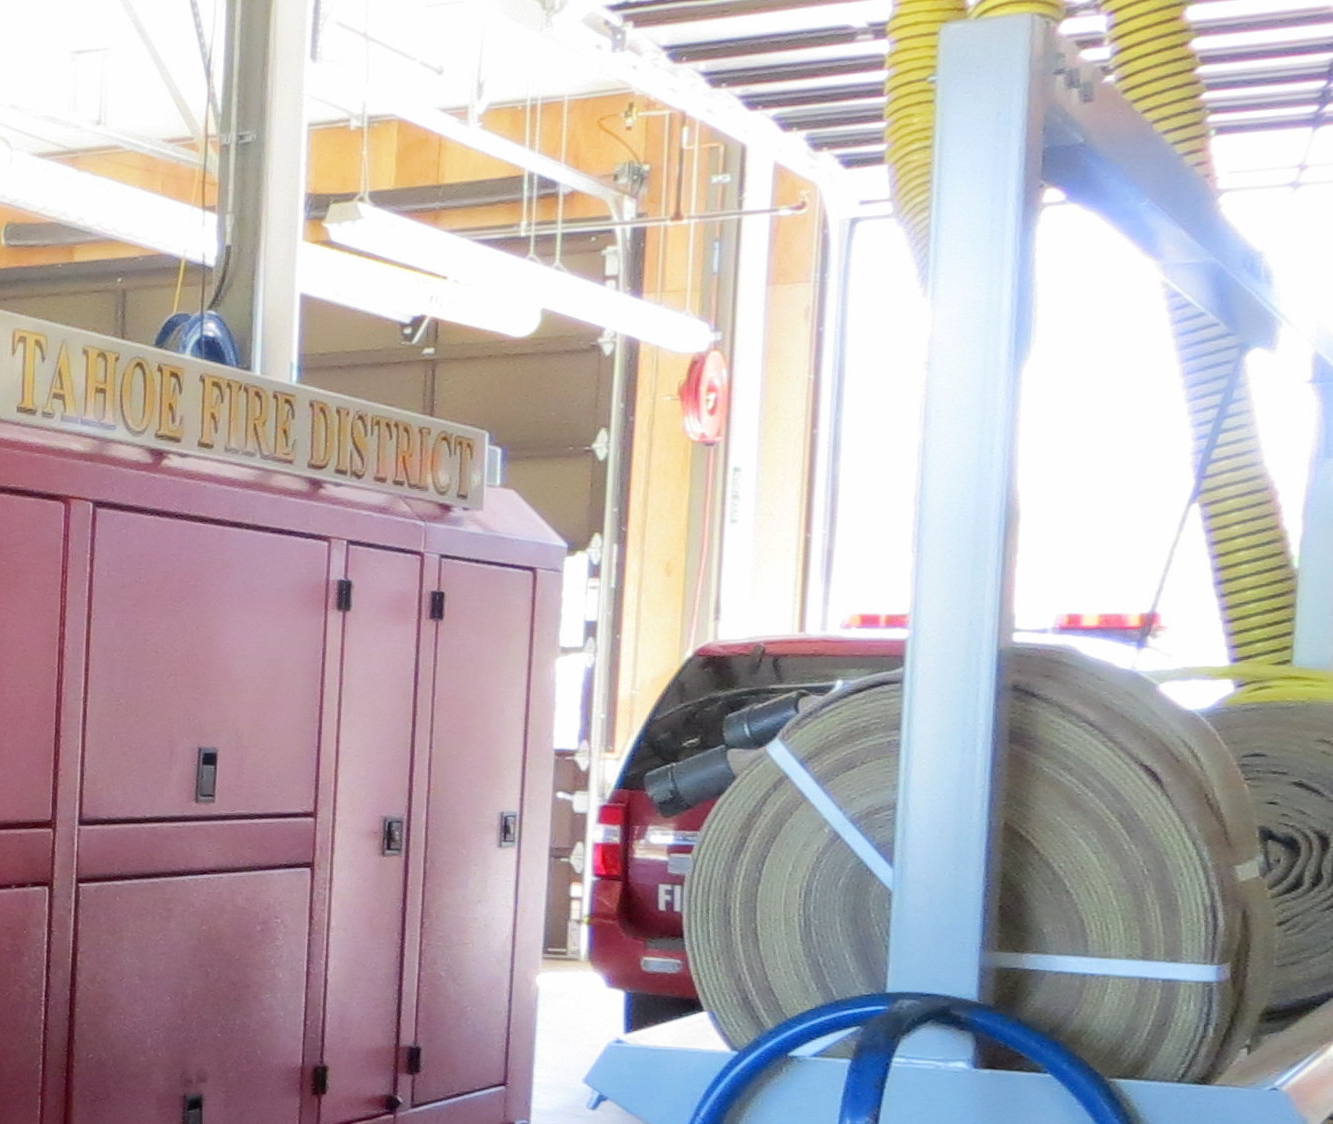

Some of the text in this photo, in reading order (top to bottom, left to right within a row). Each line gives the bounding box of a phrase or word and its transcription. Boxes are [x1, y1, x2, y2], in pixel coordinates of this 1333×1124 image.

[11, 328, 185, 443] TAHOE
[197, 373, 297, 465] FIRE
[307, 400, 475, 499] DISTRICT
[658, 883, 682, 912] FI
